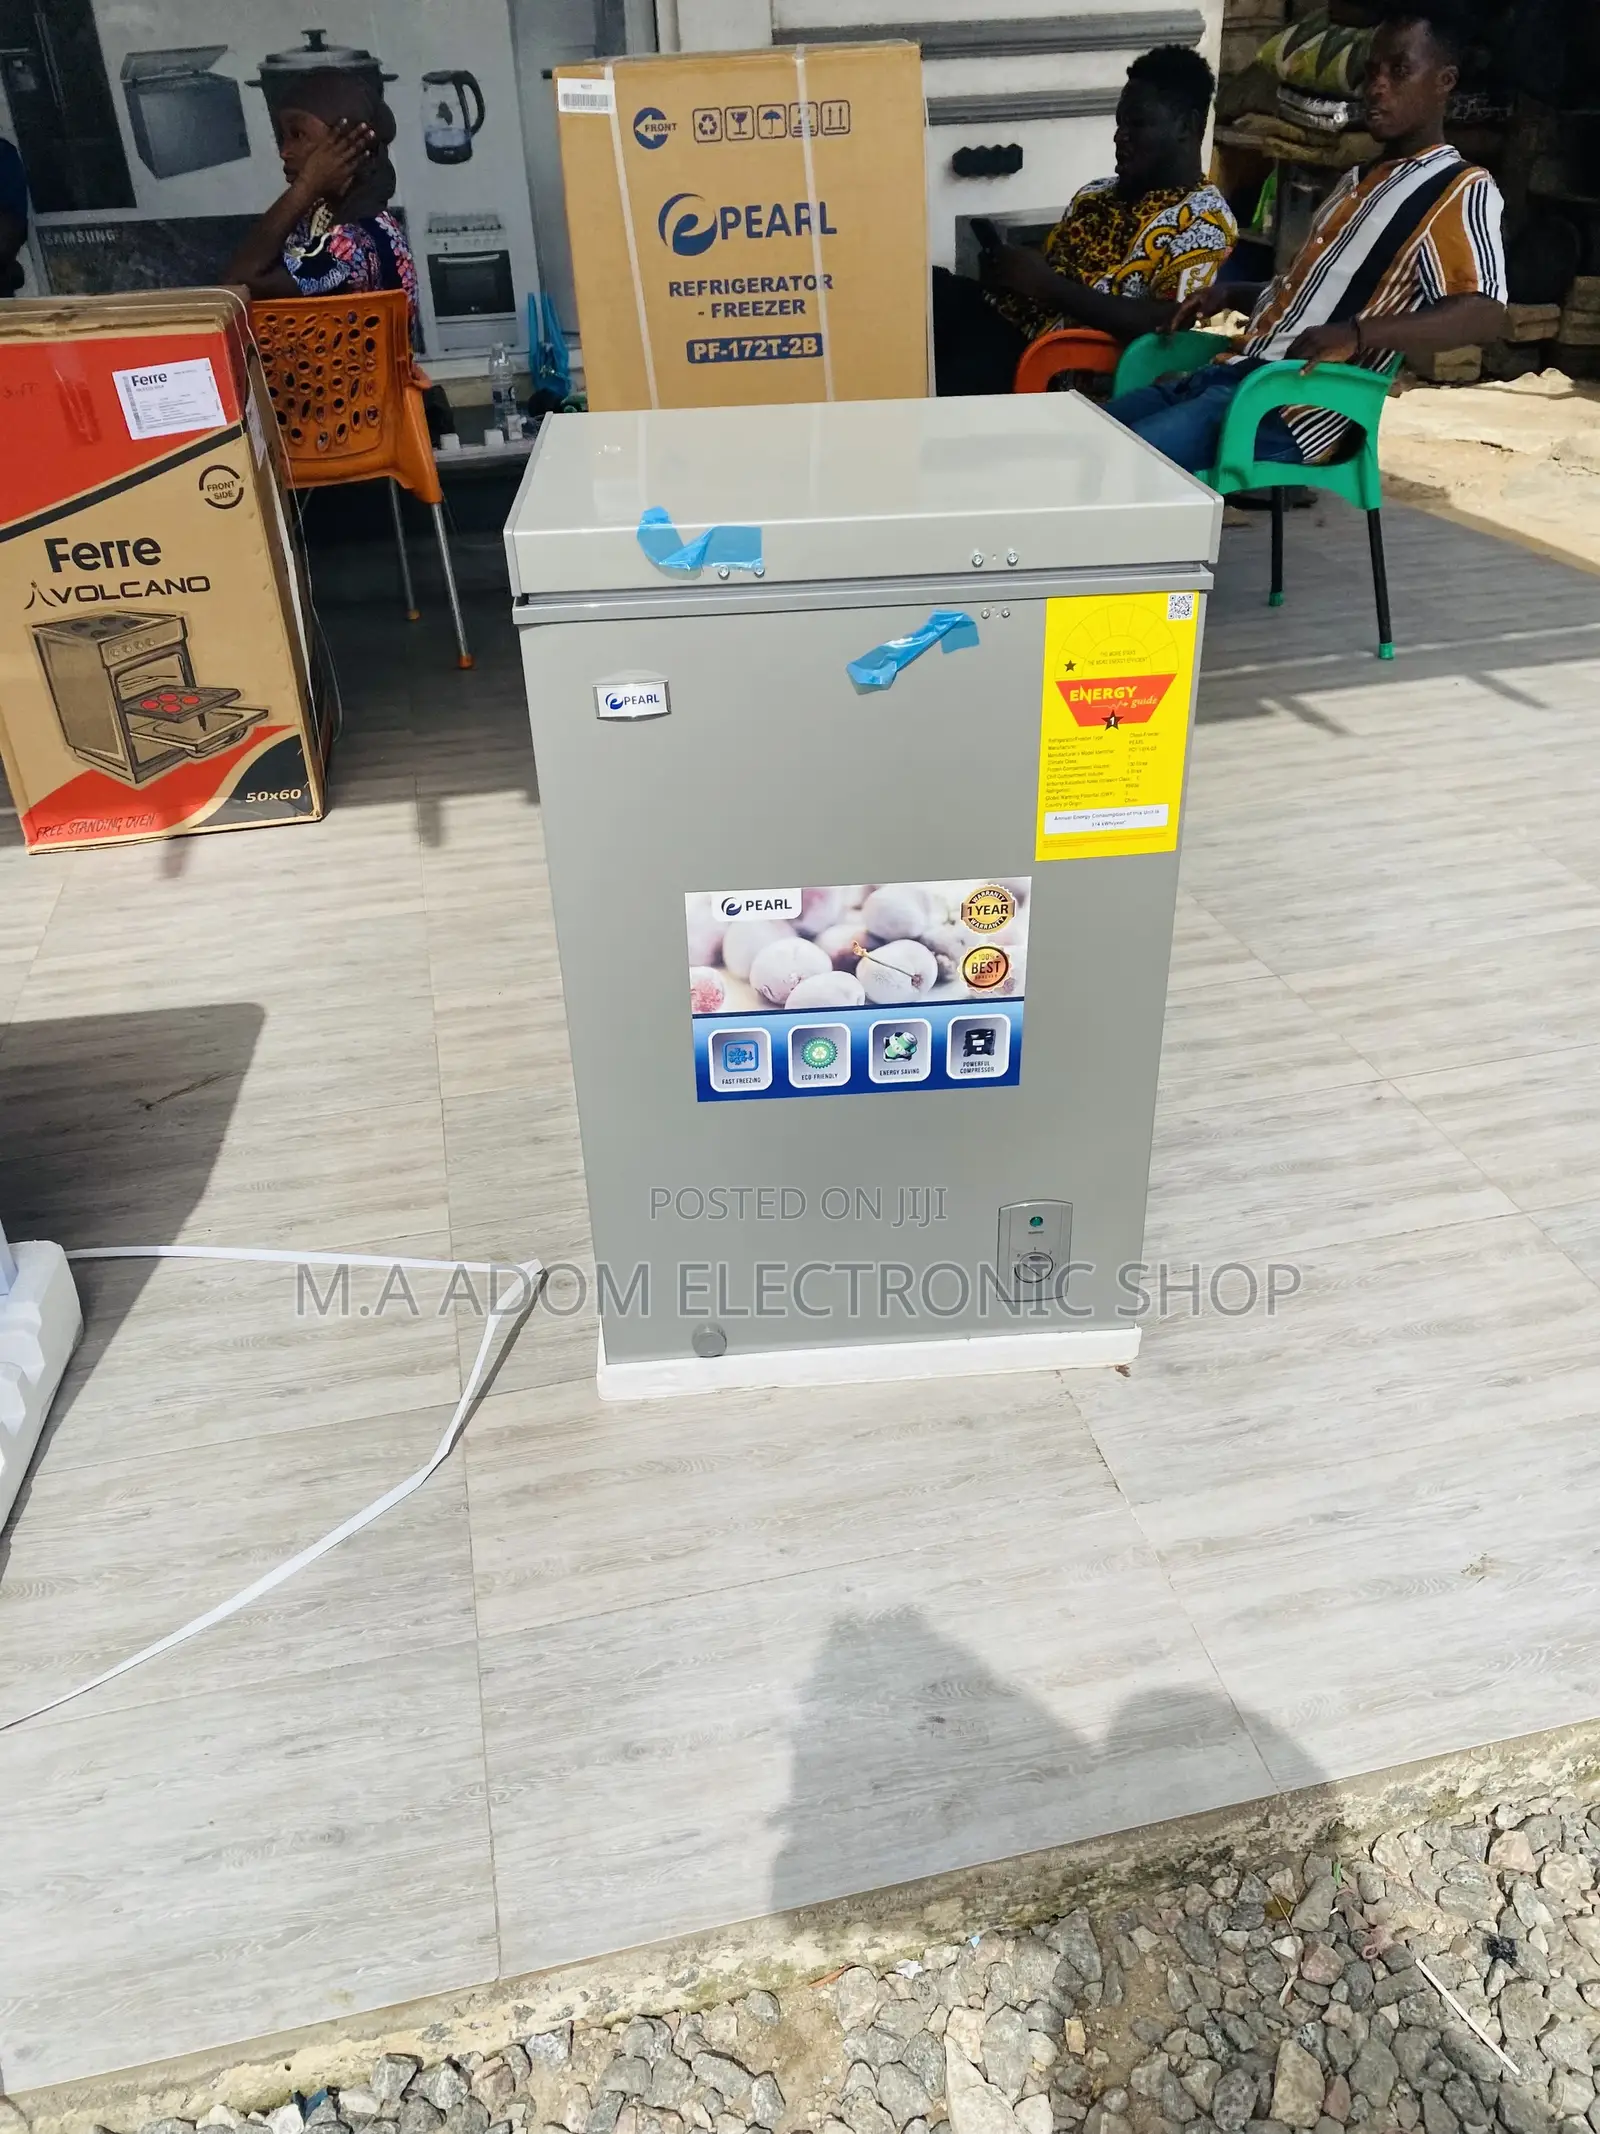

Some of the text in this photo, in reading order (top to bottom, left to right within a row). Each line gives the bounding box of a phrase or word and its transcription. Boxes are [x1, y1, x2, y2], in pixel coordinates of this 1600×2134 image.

[644, 122, 678, 133] FRONT
[720, 202, 838, 240] PEARL
[43, 229, 116, 246] SAMSUNG
[668, 273, 834, 298] REFRIGERATOR
[711, 299, 806, 319] FREEZER
[693, 337, 818, 361] PF-172T-2B
[131, 373, 168, 387] Ferre
[206, 480, 236, 492] FRONT
[213, 491, 234, 500] SIDE
[44, 537, 162, 573] Ferre
[49, 575, 211, 604] VOLCANO
[624, 693, 660, 706] PEARL
[1069, 685, 1138, 705] ENERGY
[1130, 695, 1158, 709] guide
[1109, 716, 1115, 726] 1
[245, 789, 302, 803] 50x60
[36, 812, 157, 840] FREE STANDING OVEN
[972, 889, 1006, 903] WARRANTY
[745, 898, 793, 911] PEARL
[967, 904, 1009, 916] 1 YEAR
[970, 918, 1005, 930] WARRANTY
[971, 961, 1001, 975] BEST
[880, 1069, 900, 1077] ENERGY
[960, 1066, 995, 1074] COMPRESSOR
